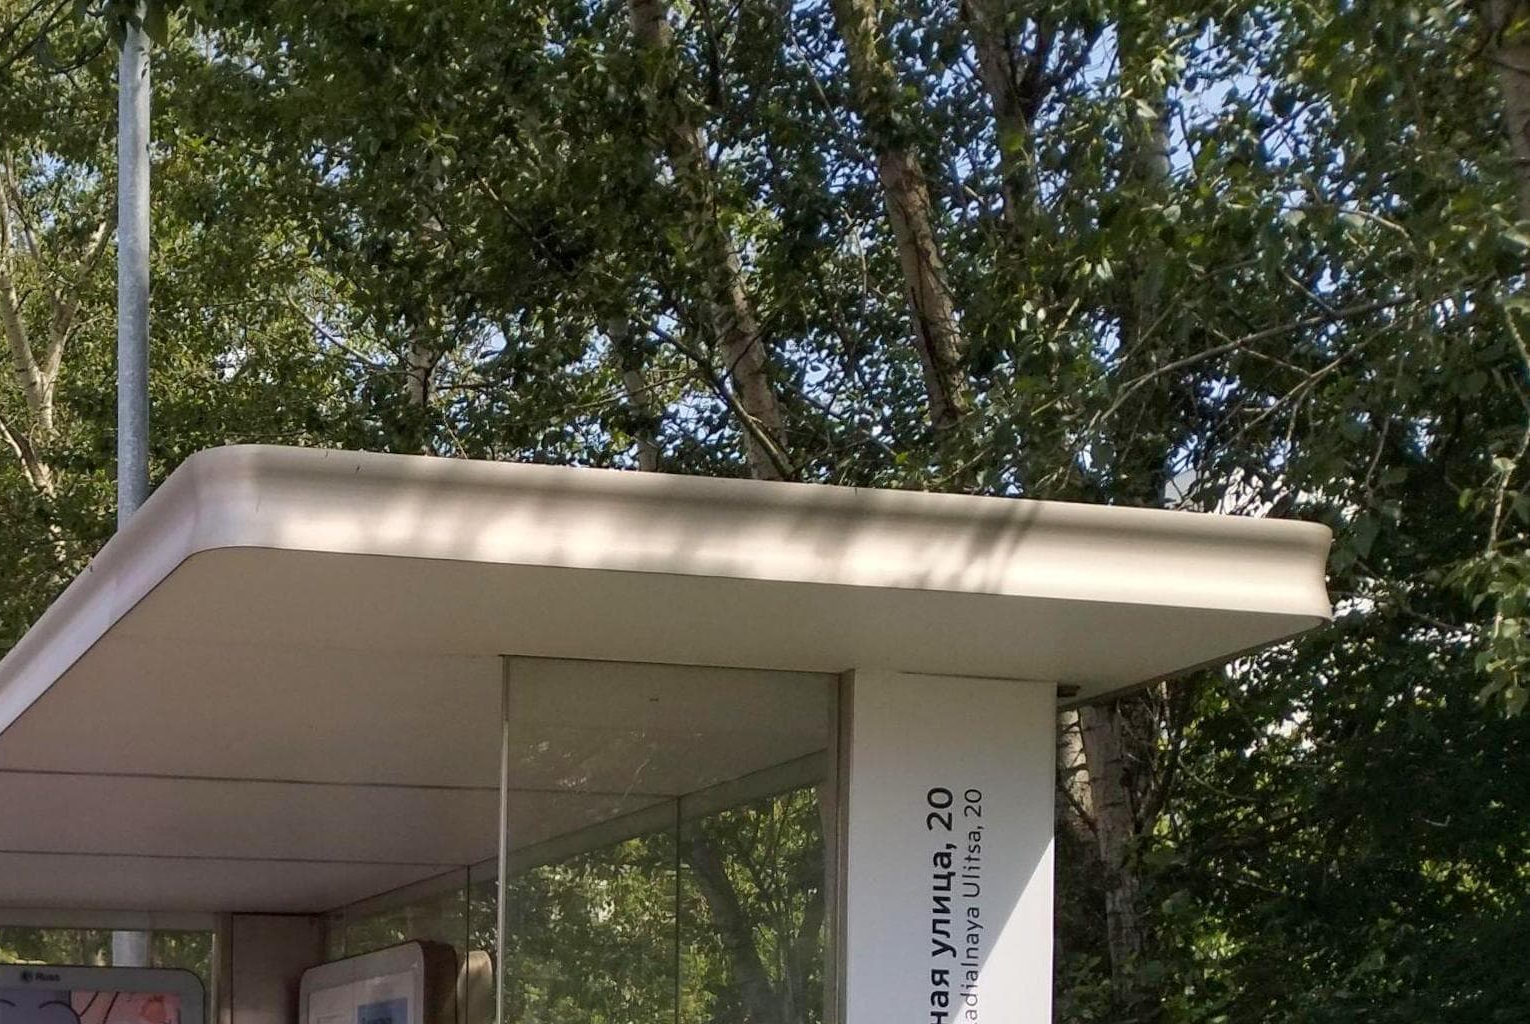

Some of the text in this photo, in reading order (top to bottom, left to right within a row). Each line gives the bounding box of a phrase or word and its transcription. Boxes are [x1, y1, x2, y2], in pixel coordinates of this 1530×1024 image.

[926, 787, 953, 831] 20
[963, 788, 982, 818] 20
[961, 825, 985, 898] Ulitsa,
[931, 843, 958, 958] улица,
